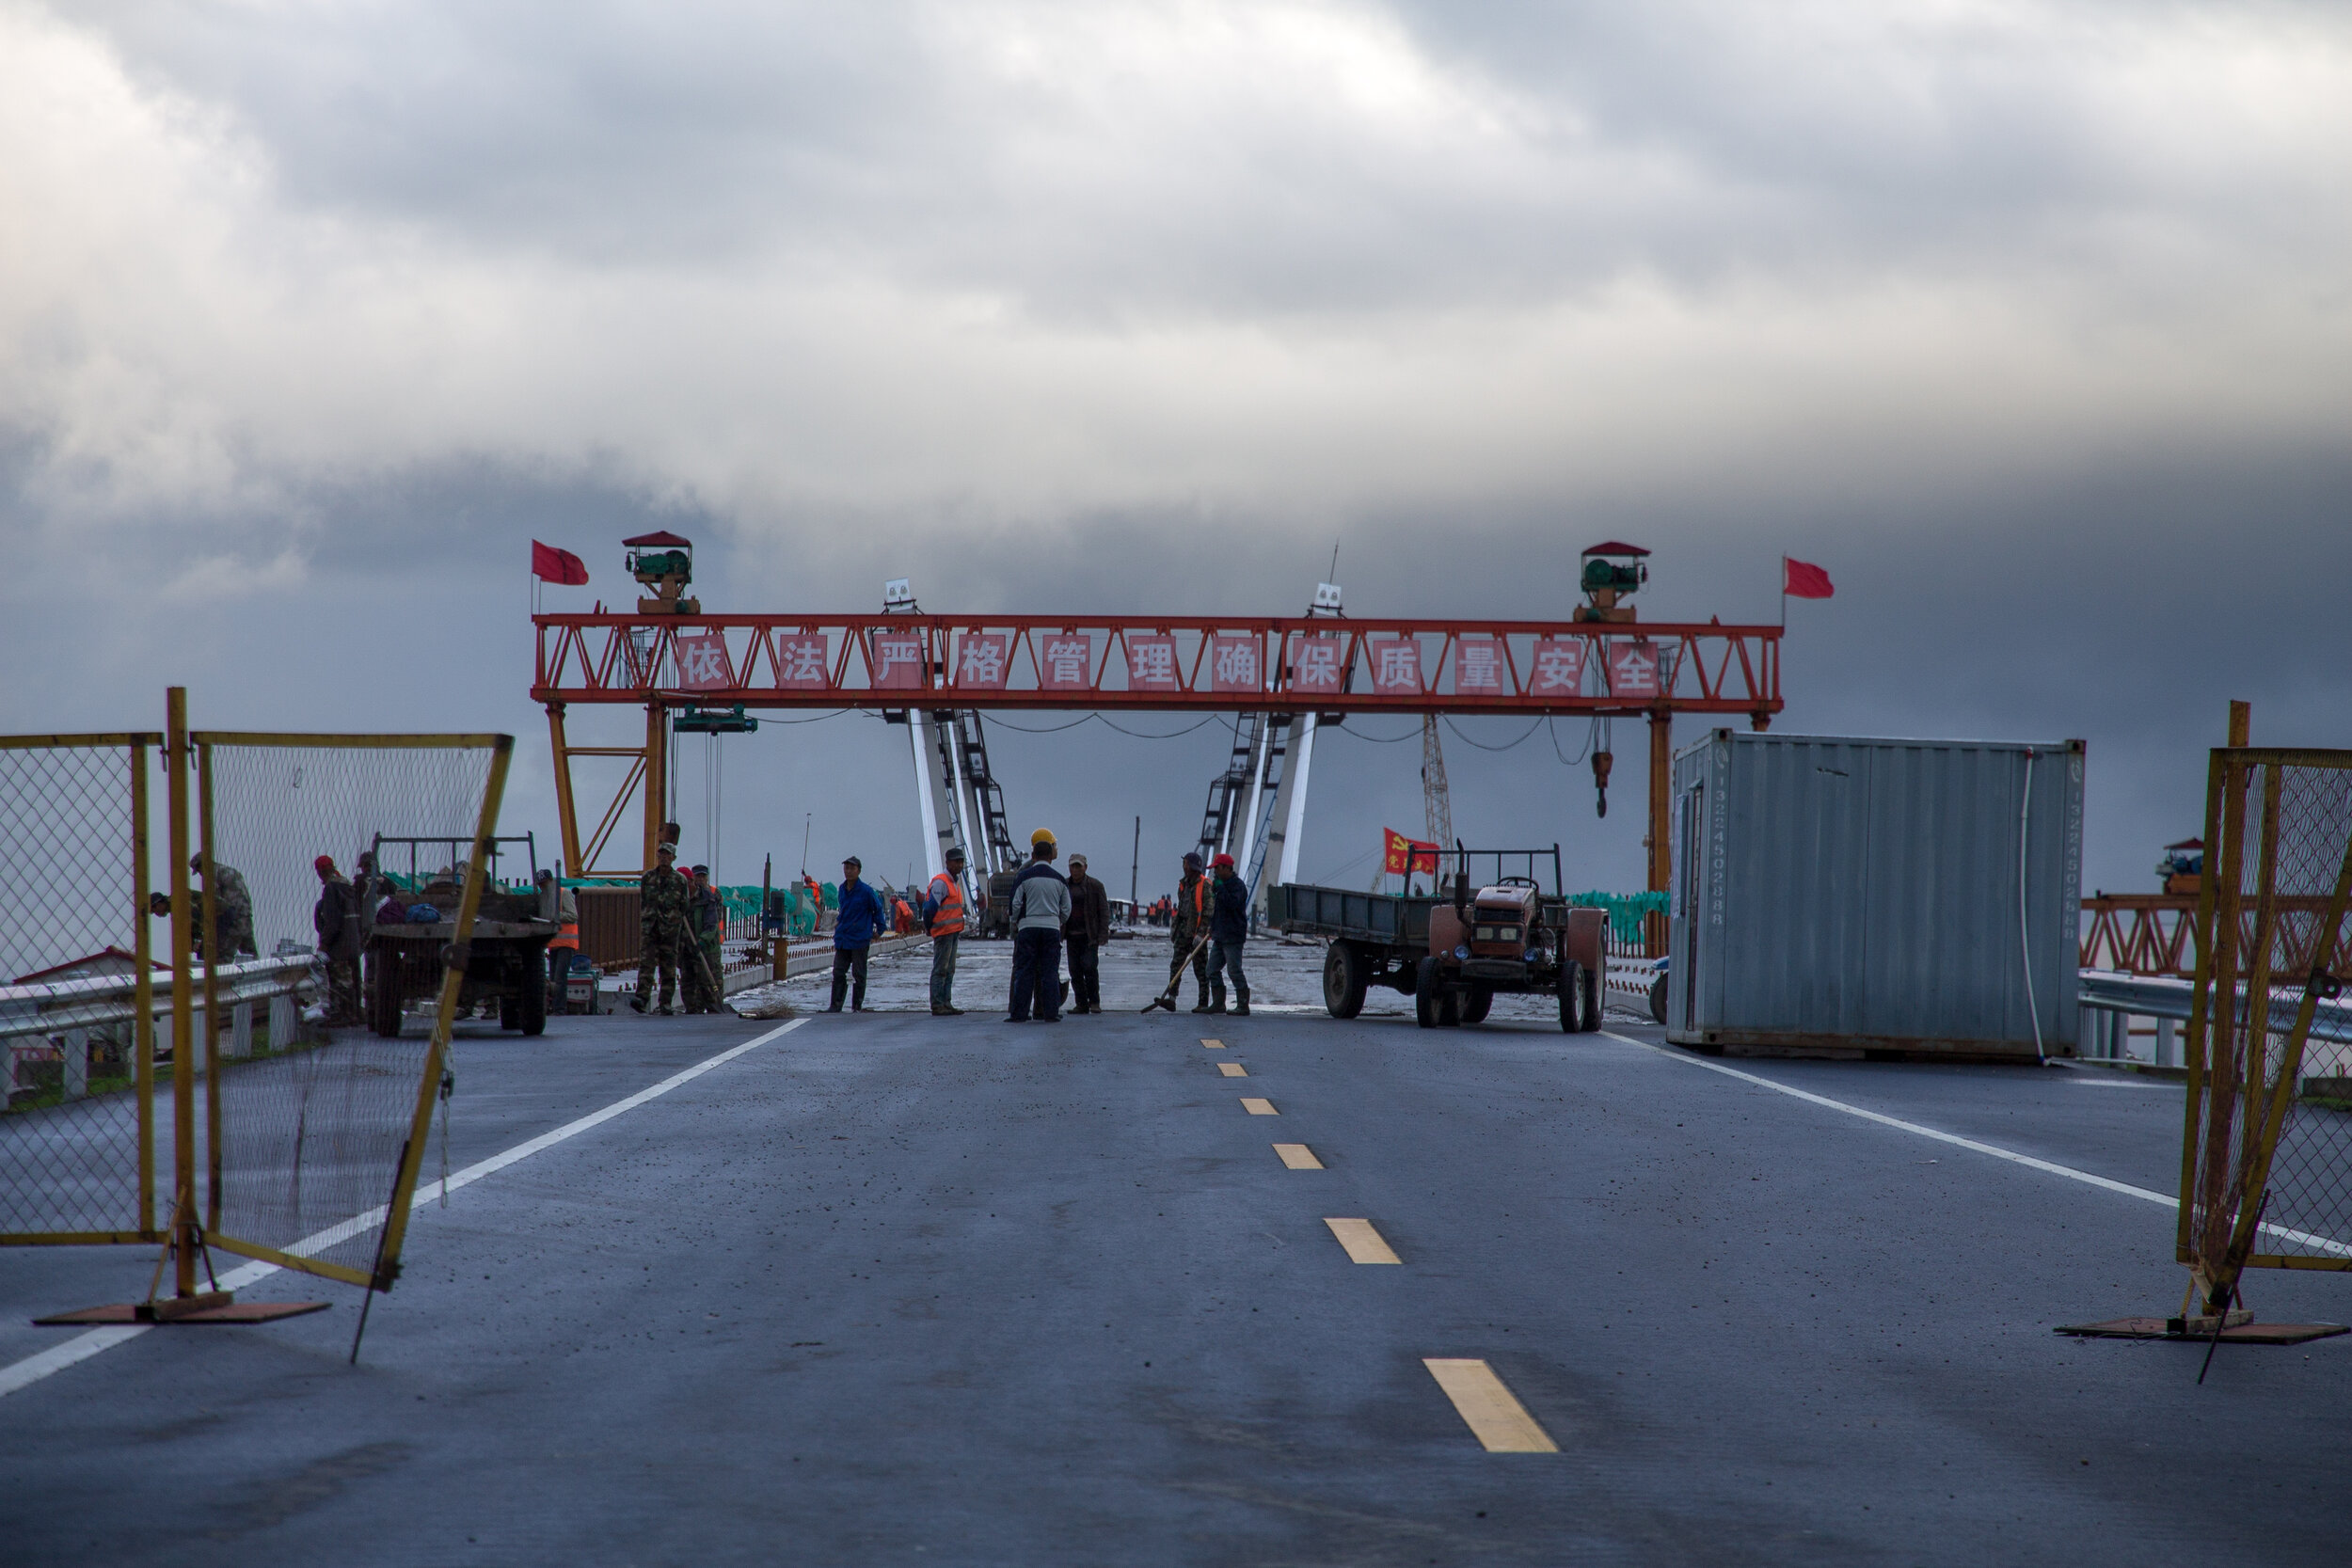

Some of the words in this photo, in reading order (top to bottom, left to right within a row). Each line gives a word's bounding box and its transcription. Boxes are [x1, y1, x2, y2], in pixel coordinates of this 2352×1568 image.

[682, 641, 1655, 689] 依法严格管理确保质量安全
